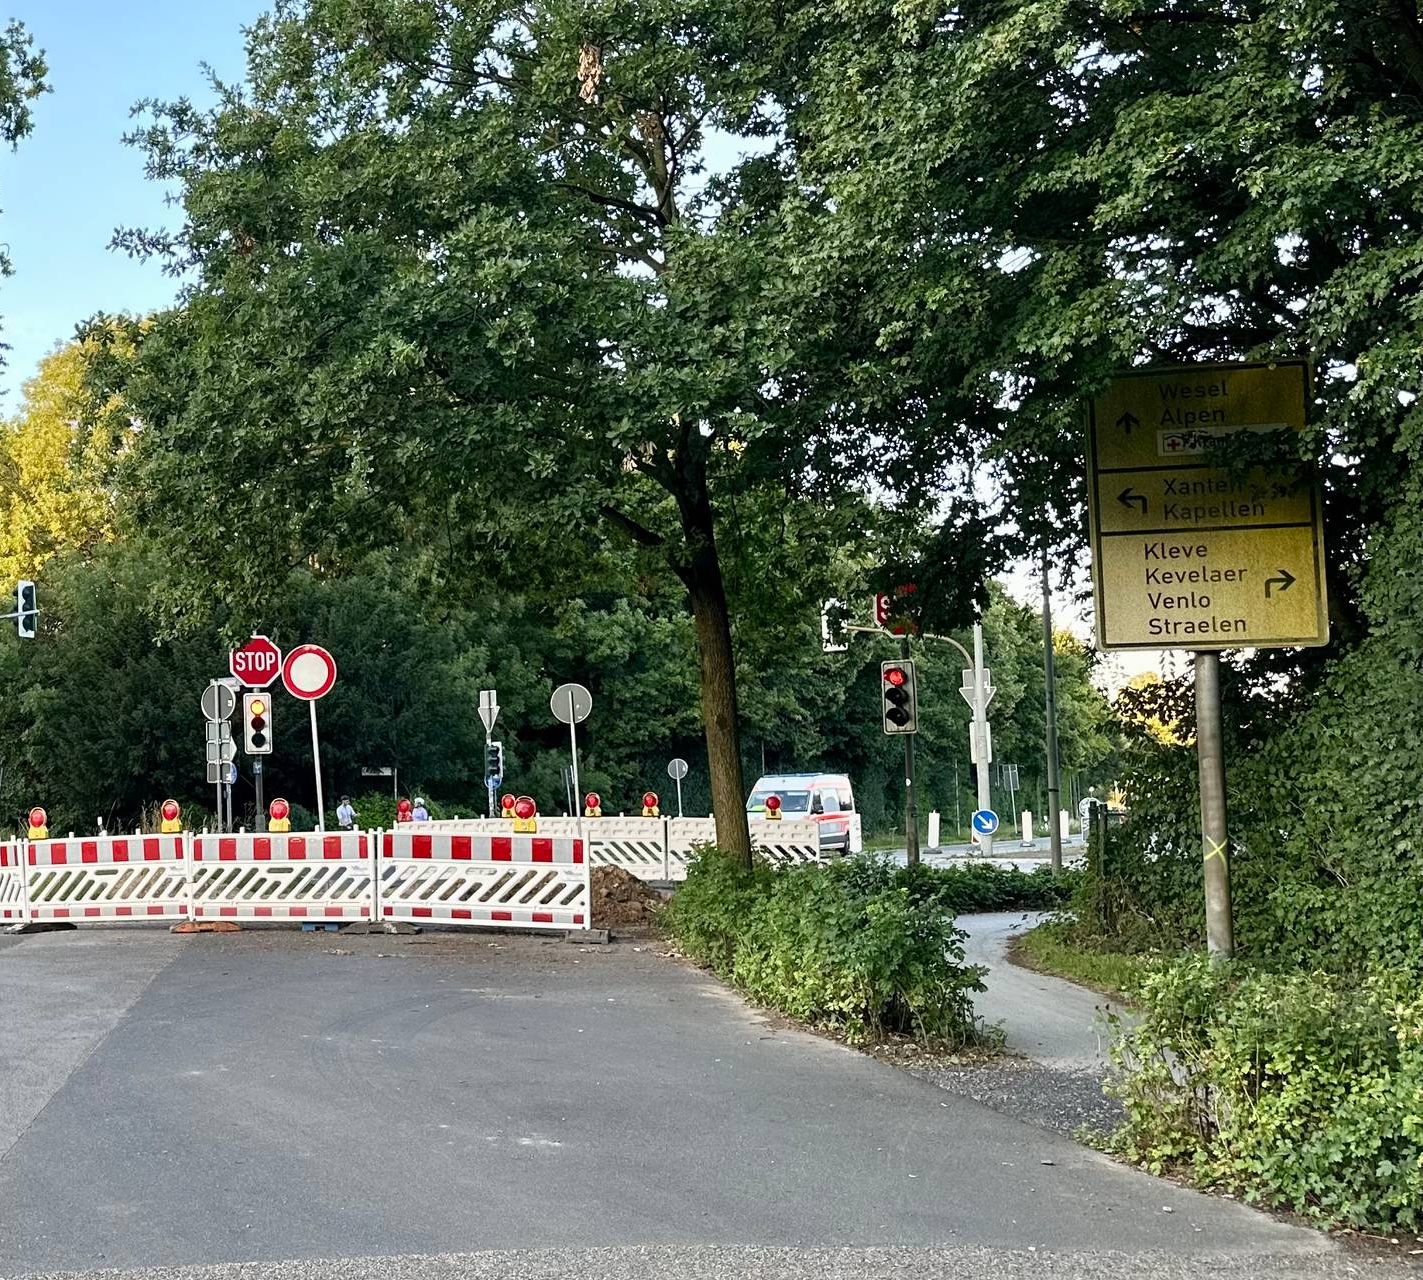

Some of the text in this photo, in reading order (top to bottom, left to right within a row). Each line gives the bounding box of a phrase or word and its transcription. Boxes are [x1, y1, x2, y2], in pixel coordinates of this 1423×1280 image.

[1159, 380, 1228, 400] Wesel
[1159, 408, 1226, 428] Alpen
[1163, 502, 1266, 523] Kapellen
[1144, 542, 1208, 560] Kleve
[1145, 566, 1248, 585] Kevelaer
[1148, 591, 1211, 609] Venlo
[1148, 616, 1247, 635] Straelen
[235, 651, 276, 672] STOP
